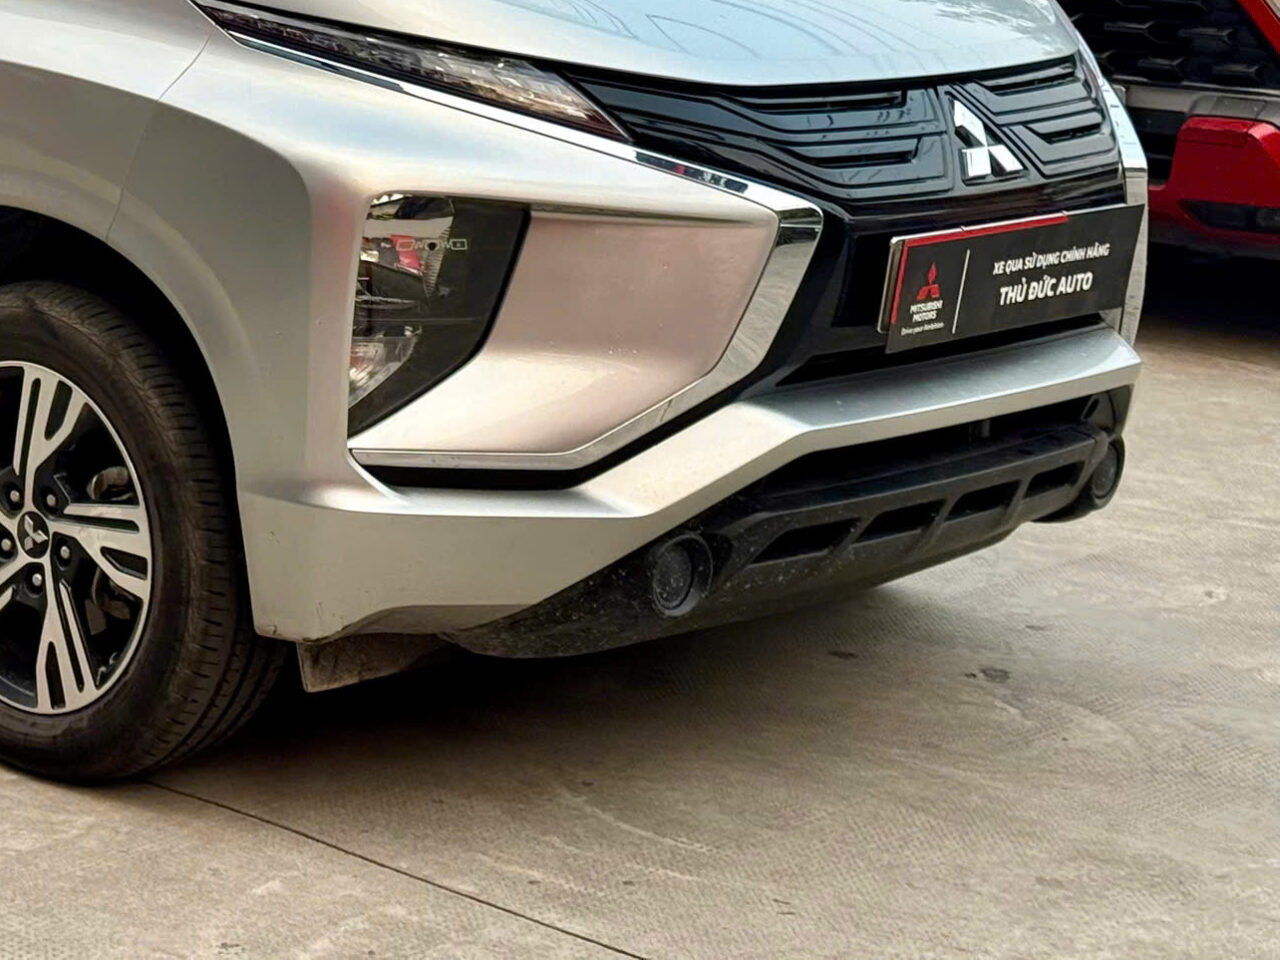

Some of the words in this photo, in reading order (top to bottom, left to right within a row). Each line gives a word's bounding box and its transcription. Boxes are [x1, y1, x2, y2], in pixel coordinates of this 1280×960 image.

[993, 261, 1005, 275] XE
[1005, 258, 1023, 275] QUA
[1036, 252, 1061, 269] DỤNG
[1060, 246, 1086, 263] CHÍNH
[1000, 276, 1027, 305] THỦ
[1028, 274, 1057, 300] ĐỨC
[1056, 272, 1093, 296] AUTO
[910, 300, 943, 314] MITSUBISHI
[912, 311, 937, 323] MOTORS
